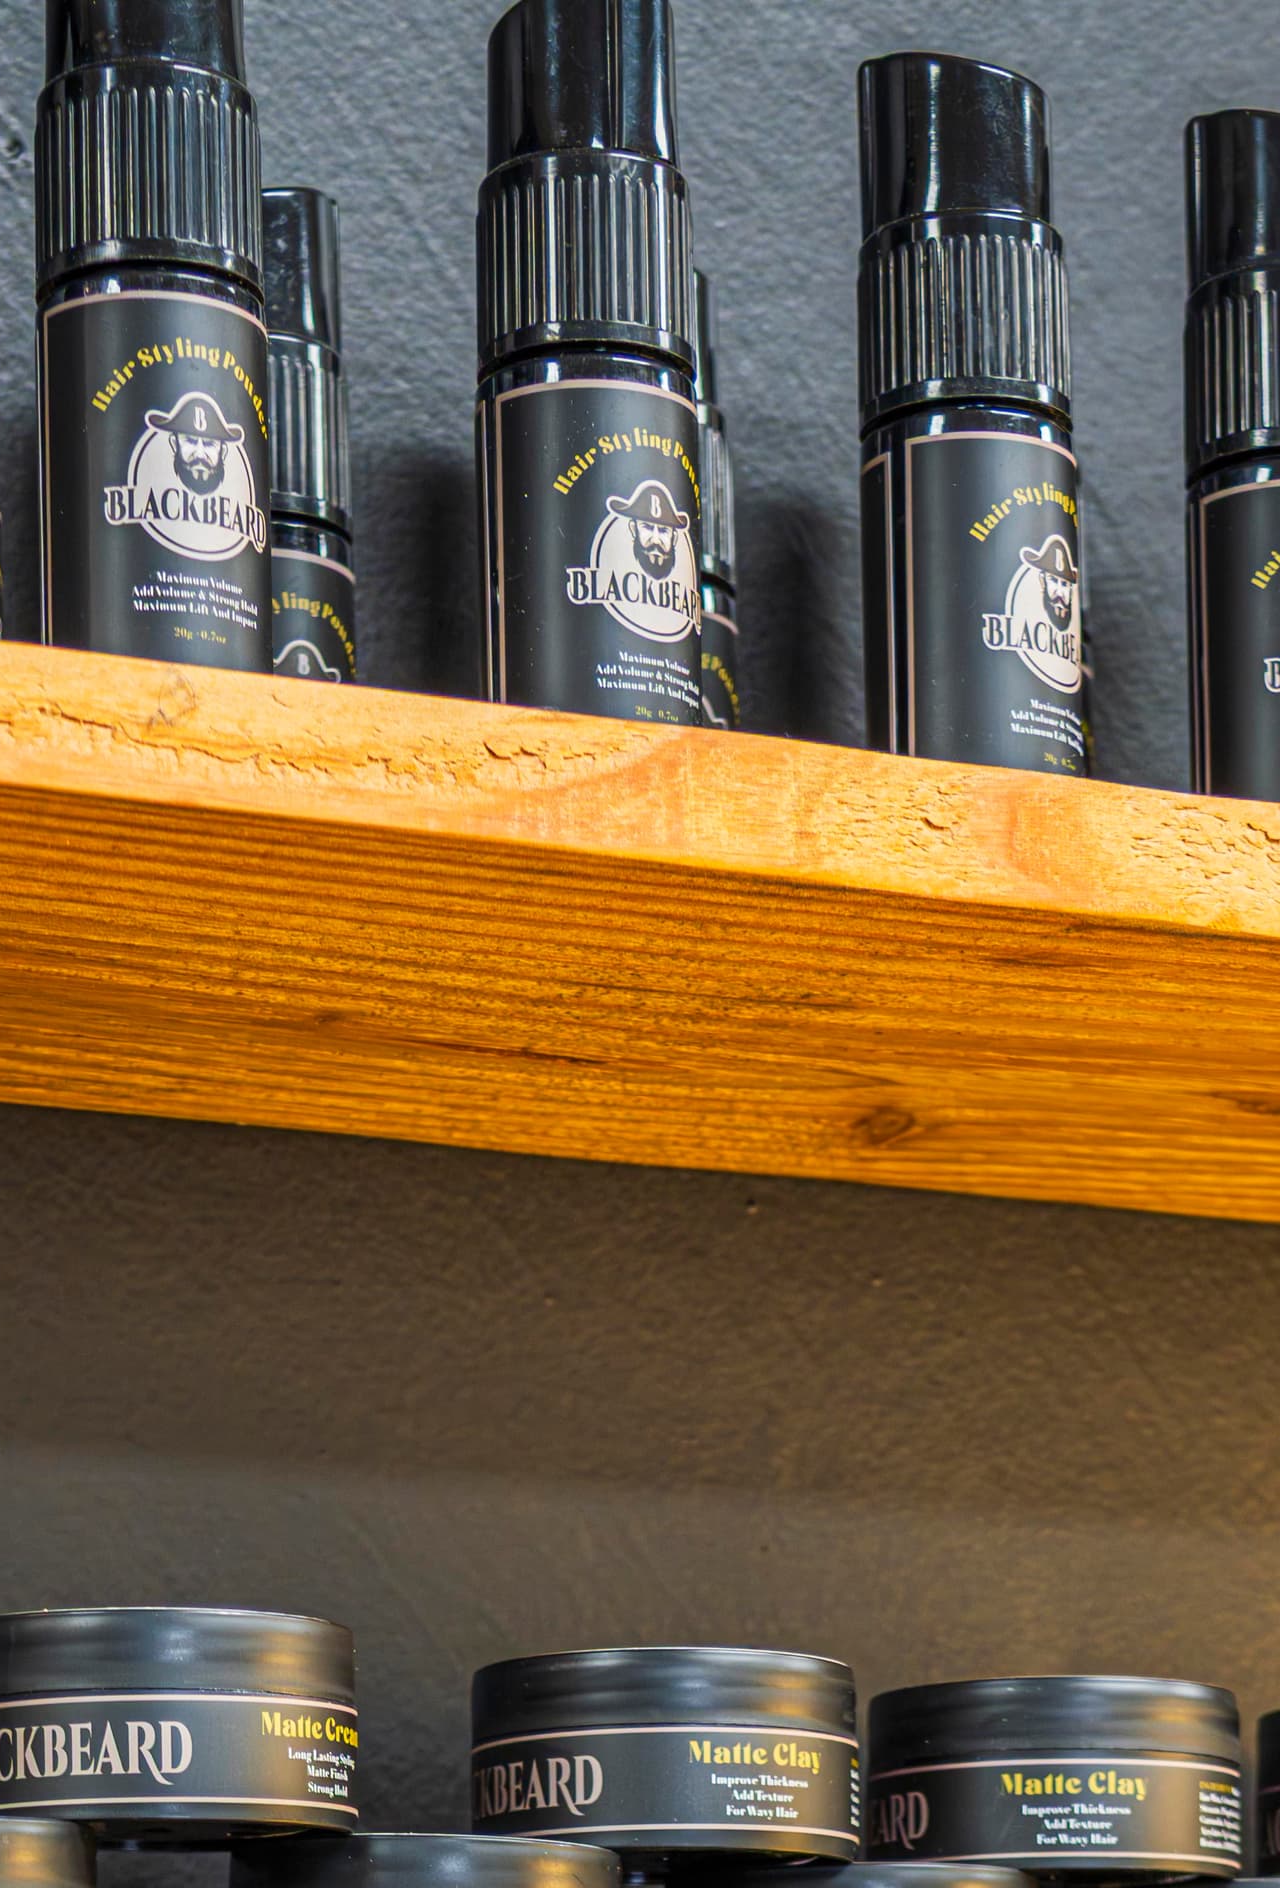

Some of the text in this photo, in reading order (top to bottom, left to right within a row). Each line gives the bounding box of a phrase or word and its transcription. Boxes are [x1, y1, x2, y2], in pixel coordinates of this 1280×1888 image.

[92, 336, 220, 412] Hair Styling
[553, 427, 672, 495] Hair Styling
[105, 487, 265, 553] BLACKBEARD
[969, 499, 1012, 543] Hair
[155, 586, 196, 599] Volume
[156, 571, 242, 595] Maximum Volume
[132, 600, 208, 615] Maximum Lift
[260, 1710, 323, 1740] Matte
[688, 1740, 822, 1775] Matte Clay
[1000, 1771, 1149, 1800] Matte Clay
